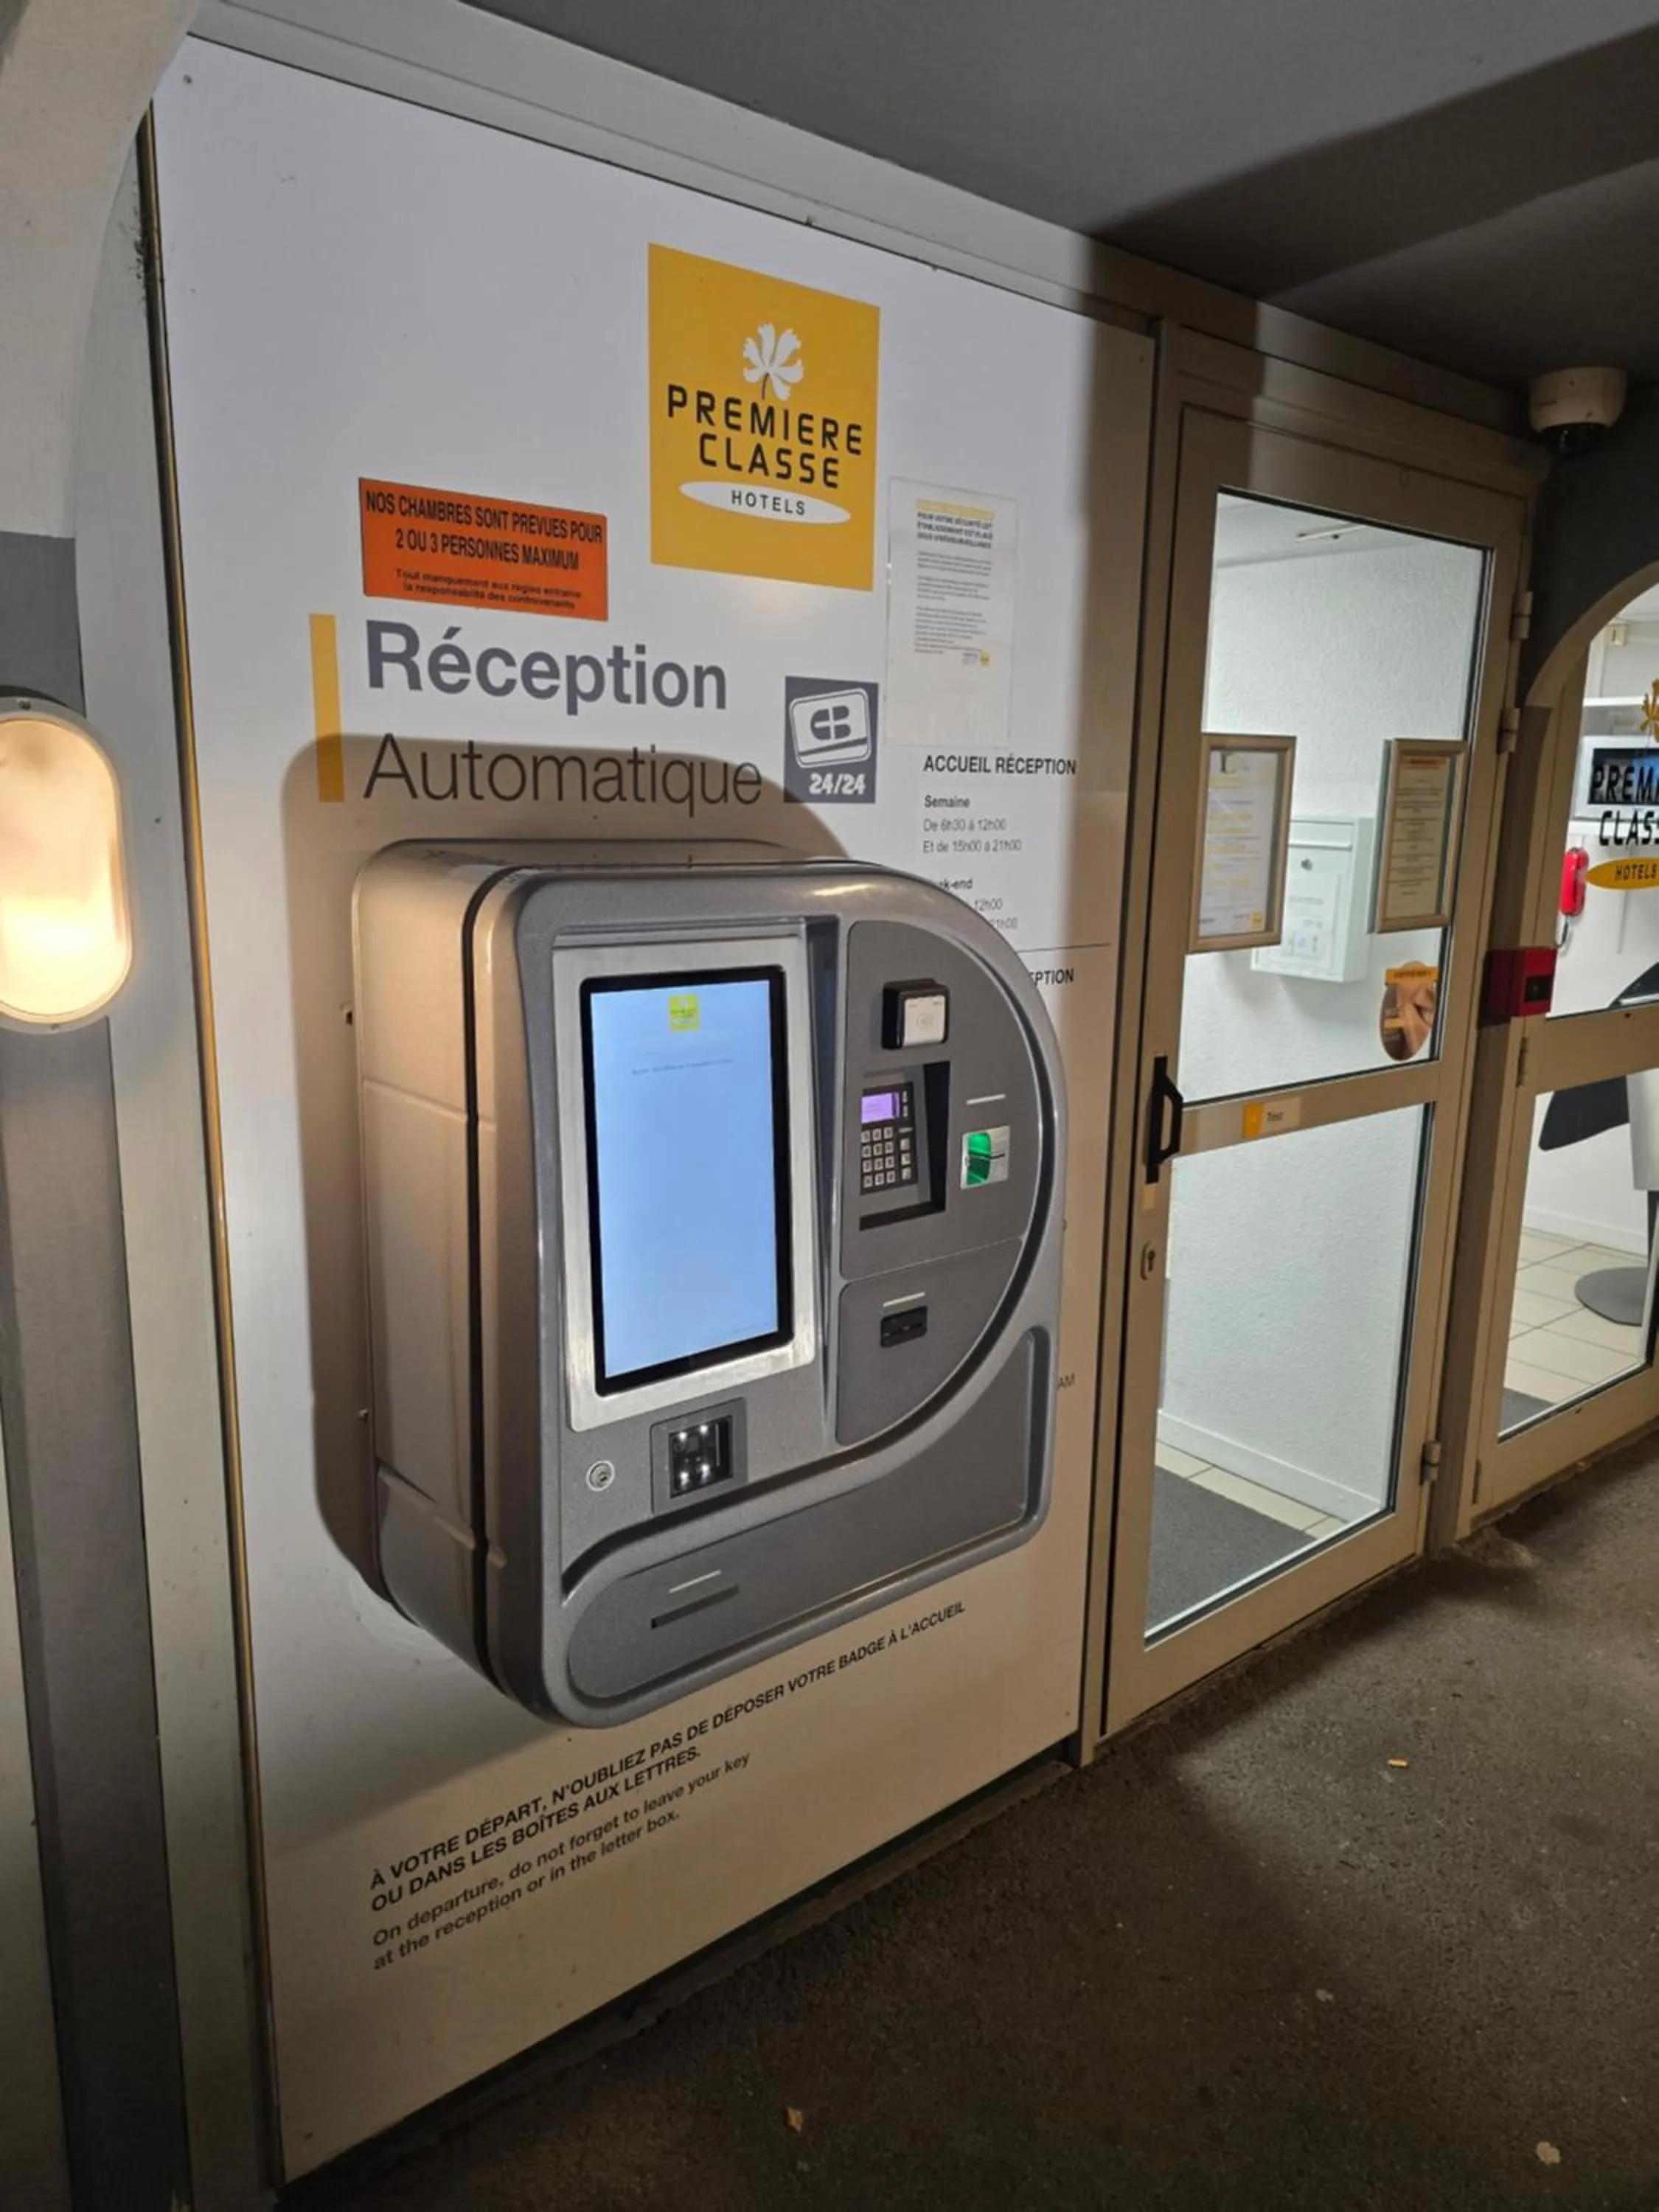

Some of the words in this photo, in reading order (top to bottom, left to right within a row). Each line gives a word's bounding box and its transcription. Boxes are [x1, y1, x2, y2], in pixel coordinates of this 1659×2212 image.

[667, 383, 863, 456] PREMIERE
[700, 434, 839, 489] CLASSE
[366, 490, 395, 515] NOS
[398, 495, 472, 526] CHAMBRES
[475, 507, 507, 529] SONT
[512, 512, 567, 538] PREVUES
[570, 521, 602, 544] POUR
[731, 489, 806, 516] HOTELS
[395, 528, 403, 549] 2
[407, 531, 426, 552] OU
[430, 532, 438, 553] 3
[442, 533, 519, 563] PERSONNES
[522, 545, 580, 571] MAXIMUM
[366, 619, 727, 715] Réception
[363, 732, 762, 818] Automatique
[808, 772, 866, 796] 24/24
[923, 754, 991, 773] ACCUEIL
[995, 754, 1077, 775] RÉCEPTION
[923, 818, 938, 832] De
[924, 794, 970, 809] Semaine
[922, 840, 933, 853] Et
[1615, 863, 1658, 880] HOTELS
[370, 1868, 386, 1891] À
[389, 1835, 460, 1879] VOTRE
[465, 1797, 547, 1846] DÉPART,
[553, 1748, 646, 1804] N'OUBLIEZ
[650, 1732, 683, 1759] PAS
[687, 1719, 709, 1741] DE
[712, 1684, 785, 1730] DÉPOSER
[787, 1660, 836, 1693] VOTRE
[838, 1635, 886, 1670] BADGE
[888, 1628, 899, 1648] À
[900, 1601, 966, 1641] L'ACCUEIL
[371, 1885, 403, 1912] OU
[409, 1856, 465, 1896] DANS
[470, 1836, 508, 1865] LES
[512, 1801, 580, 1846] BOÎTES
[583, 1782, 620, 1812] AUX
[625, 1745, 701, 1792] LETTRES.
[372, 1924, 402, 1947] On
[406, 1877, 504, 1930] departure,
[509, 1860, 532, 1880] do
[537, 1842, 565, 1867] not
[569, 1815, 619, 1851] forget
[623, 1808, 639, 1823] to
[643, 1785, 685, 1814] leave
[688, 1767, 721, 1795] your
[724, 1752, 751, 1773] key
[374, 1949, 394, 1971] at
[397, 1933, 431, 1958] the
[434, 1887, 522, 1941] reception
[526, 1874, 546, 1893] or
[550, 1863, 566, 1882] in
[570, 1848, 597, 1872] the
[600, 1825, 644, 1857] letter
[647, 1809, 681, 1834] box.
